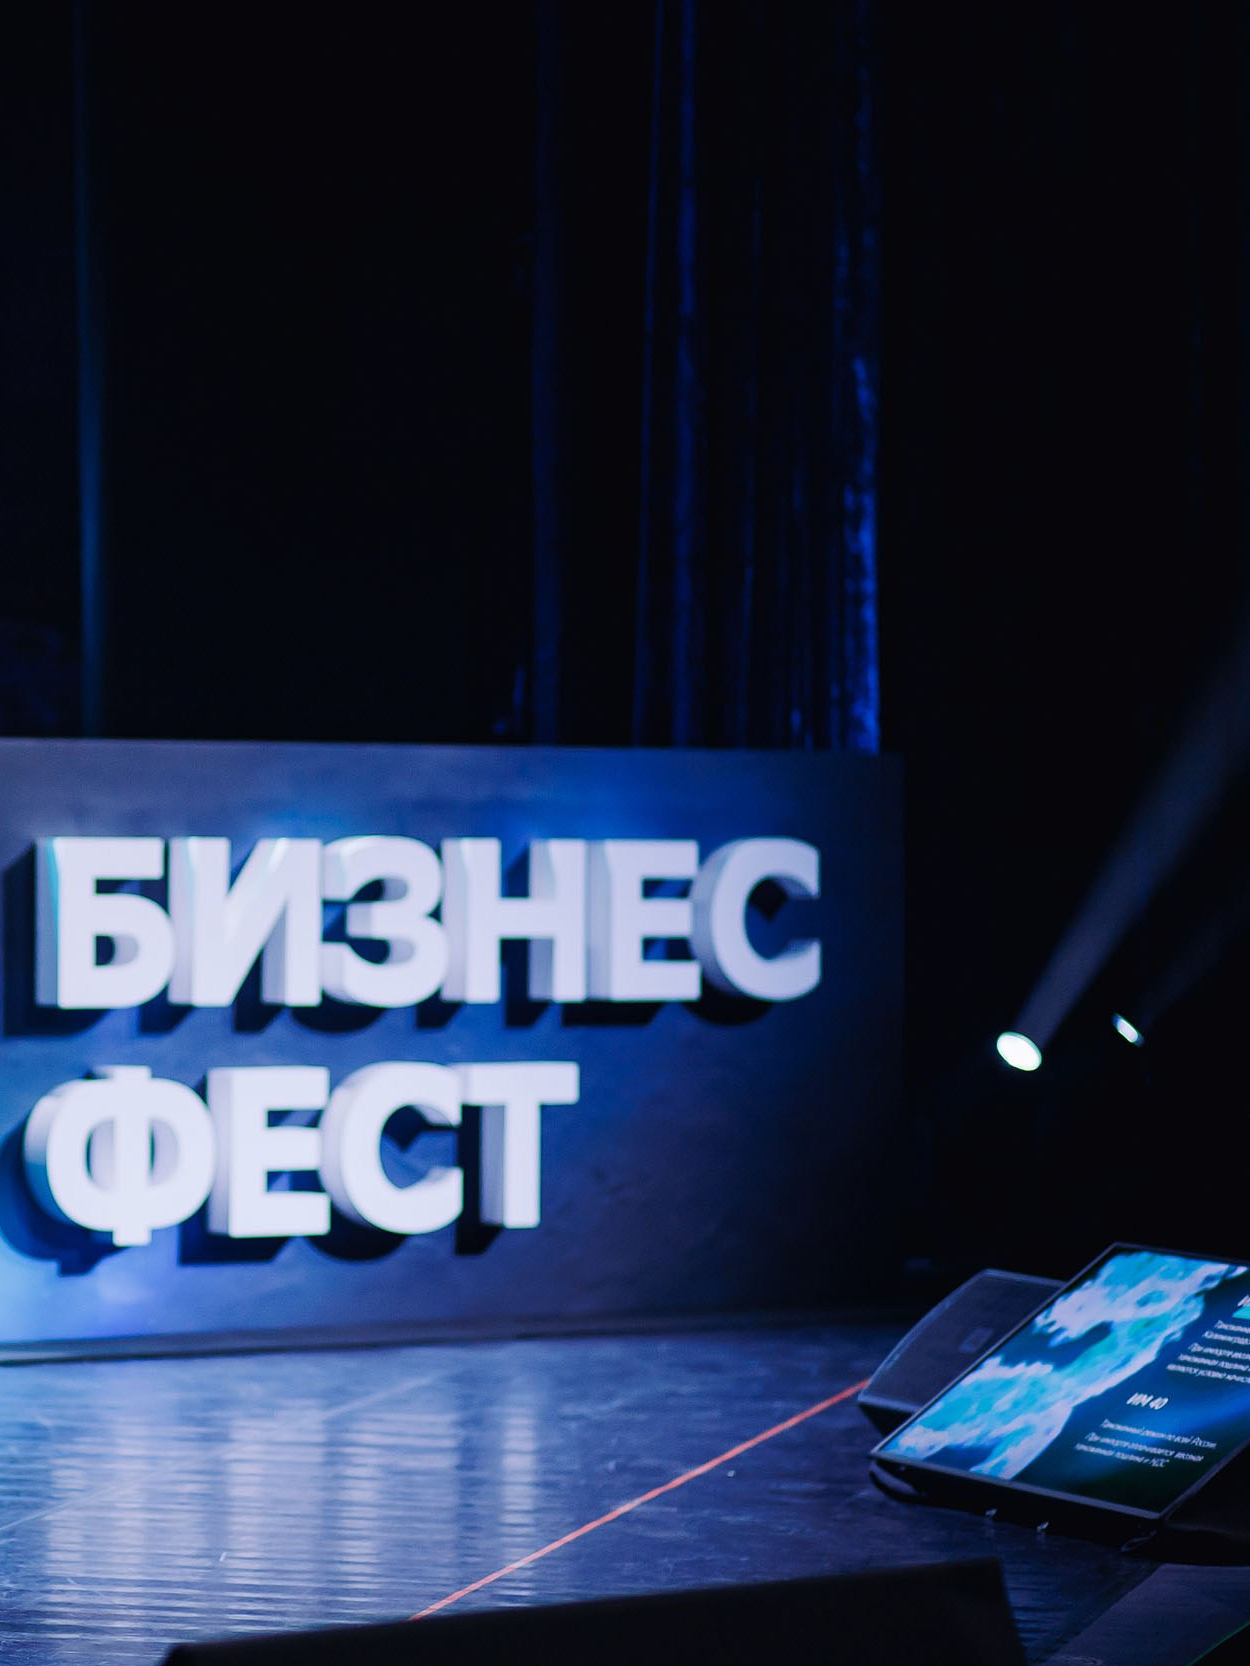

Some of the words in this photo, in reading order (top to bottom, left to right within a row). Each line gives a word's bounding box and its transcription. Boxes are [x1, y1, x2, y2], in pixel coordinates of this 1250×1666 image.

[37, 835, 821, 1010] БИЗНЕС
[27, 1061, 579, 1247] ФЕСТ
[1149, 1396, 1168, 1409] 40
